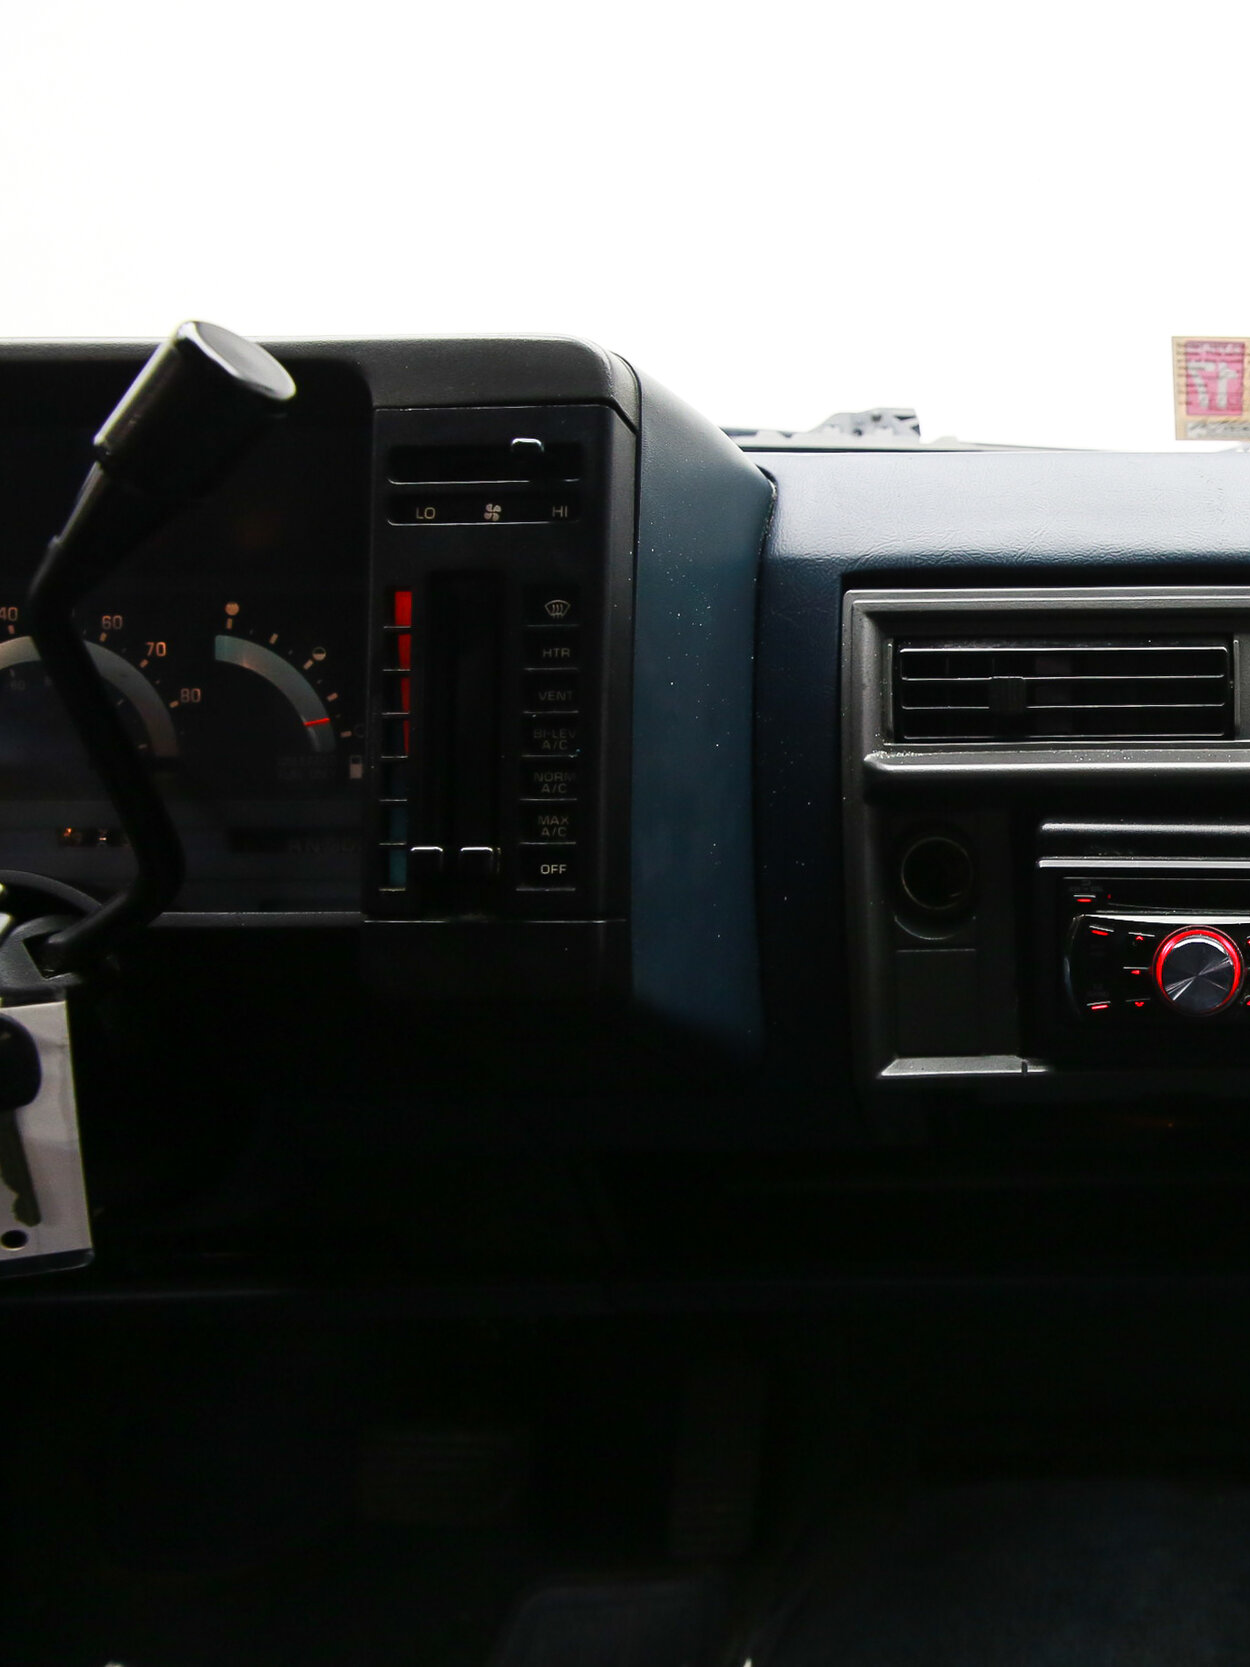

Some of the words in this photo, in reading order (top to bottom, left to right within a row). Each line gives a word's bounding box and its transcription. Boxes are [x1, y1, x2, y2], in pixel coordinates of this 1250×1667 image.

[415, 507, 436, 519] LO
[552, 506, 568, 518] HI
[0, 607, 18, 621] 40
[102, 615, 123, 630] 60
[146, 641, 167, 657] 70
[542, 648, 571, 658] HTR
[180, 688, 201, 703] 80
[538, 691, 573, 701] VENT
[533, 729, 576, 739] BI-LEV
[541, 740, 568, 750] A/C
[541, 783, 568, 793] A/C
[538, 815, 569, 826] MAX
[541, 826, 568, 837] A/C
[540, 864, 567, 875] OFF
